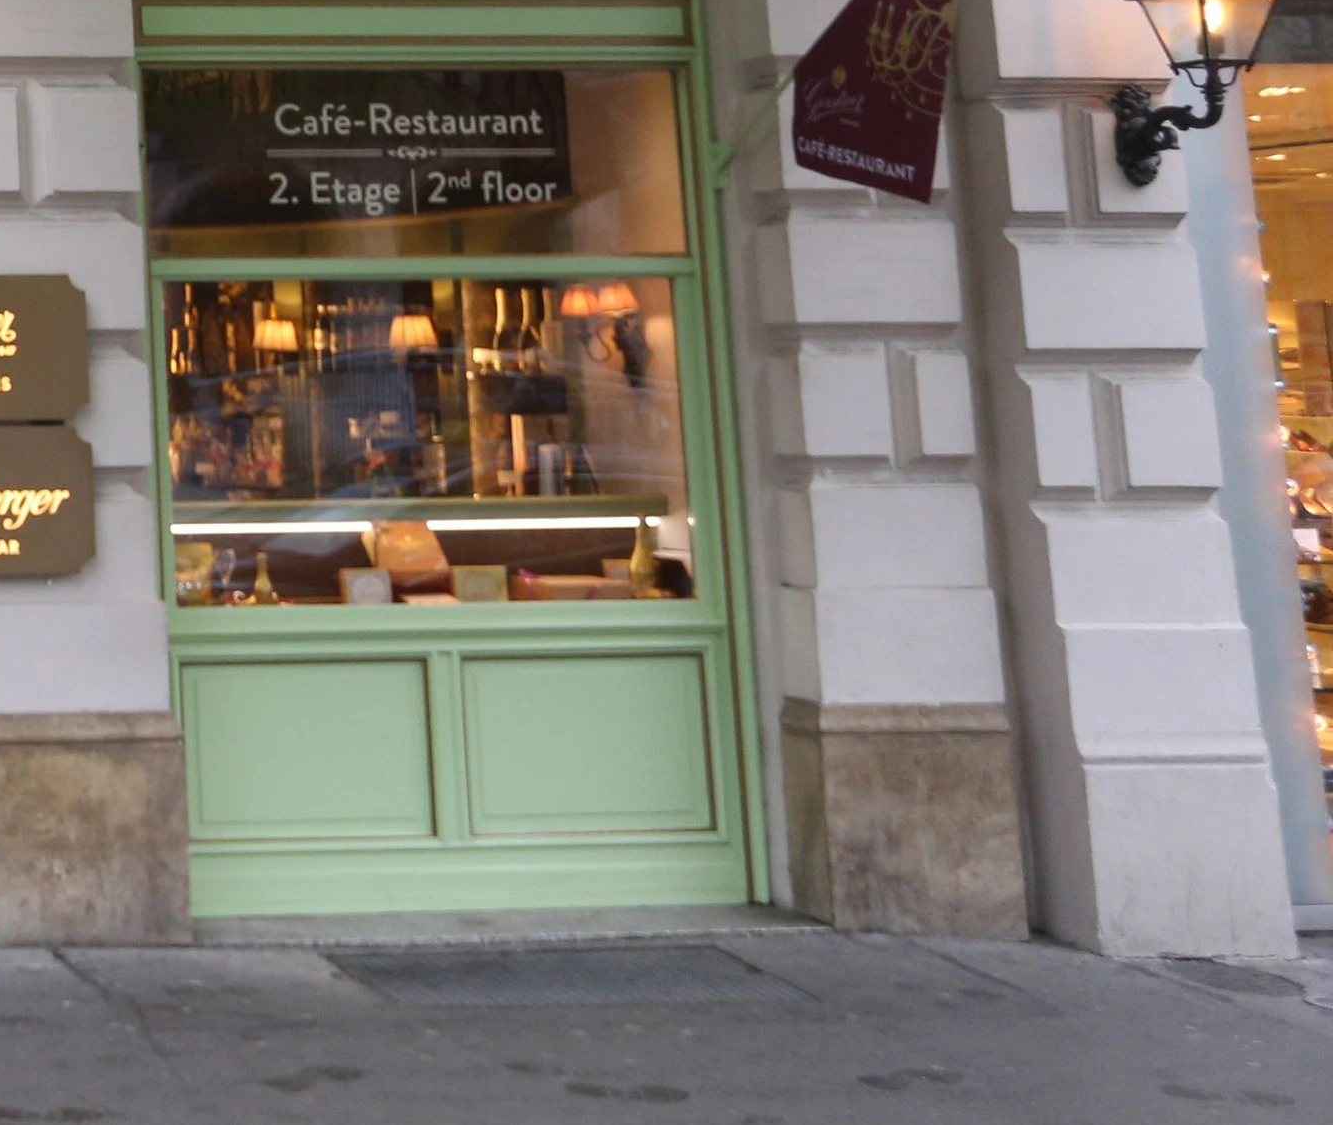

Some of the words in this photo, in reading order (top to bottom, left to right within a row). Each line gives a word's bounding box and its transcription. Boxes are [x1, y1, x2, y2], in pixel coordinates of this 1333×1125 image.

[273, 103, 544, 136] Café-Restaurant
[269, 172, 299, 205] 2.
[311, 171, 401, 215] Etage
[427, 171, 472, 204] 2nd
[481, 170, 557, 203] floor
